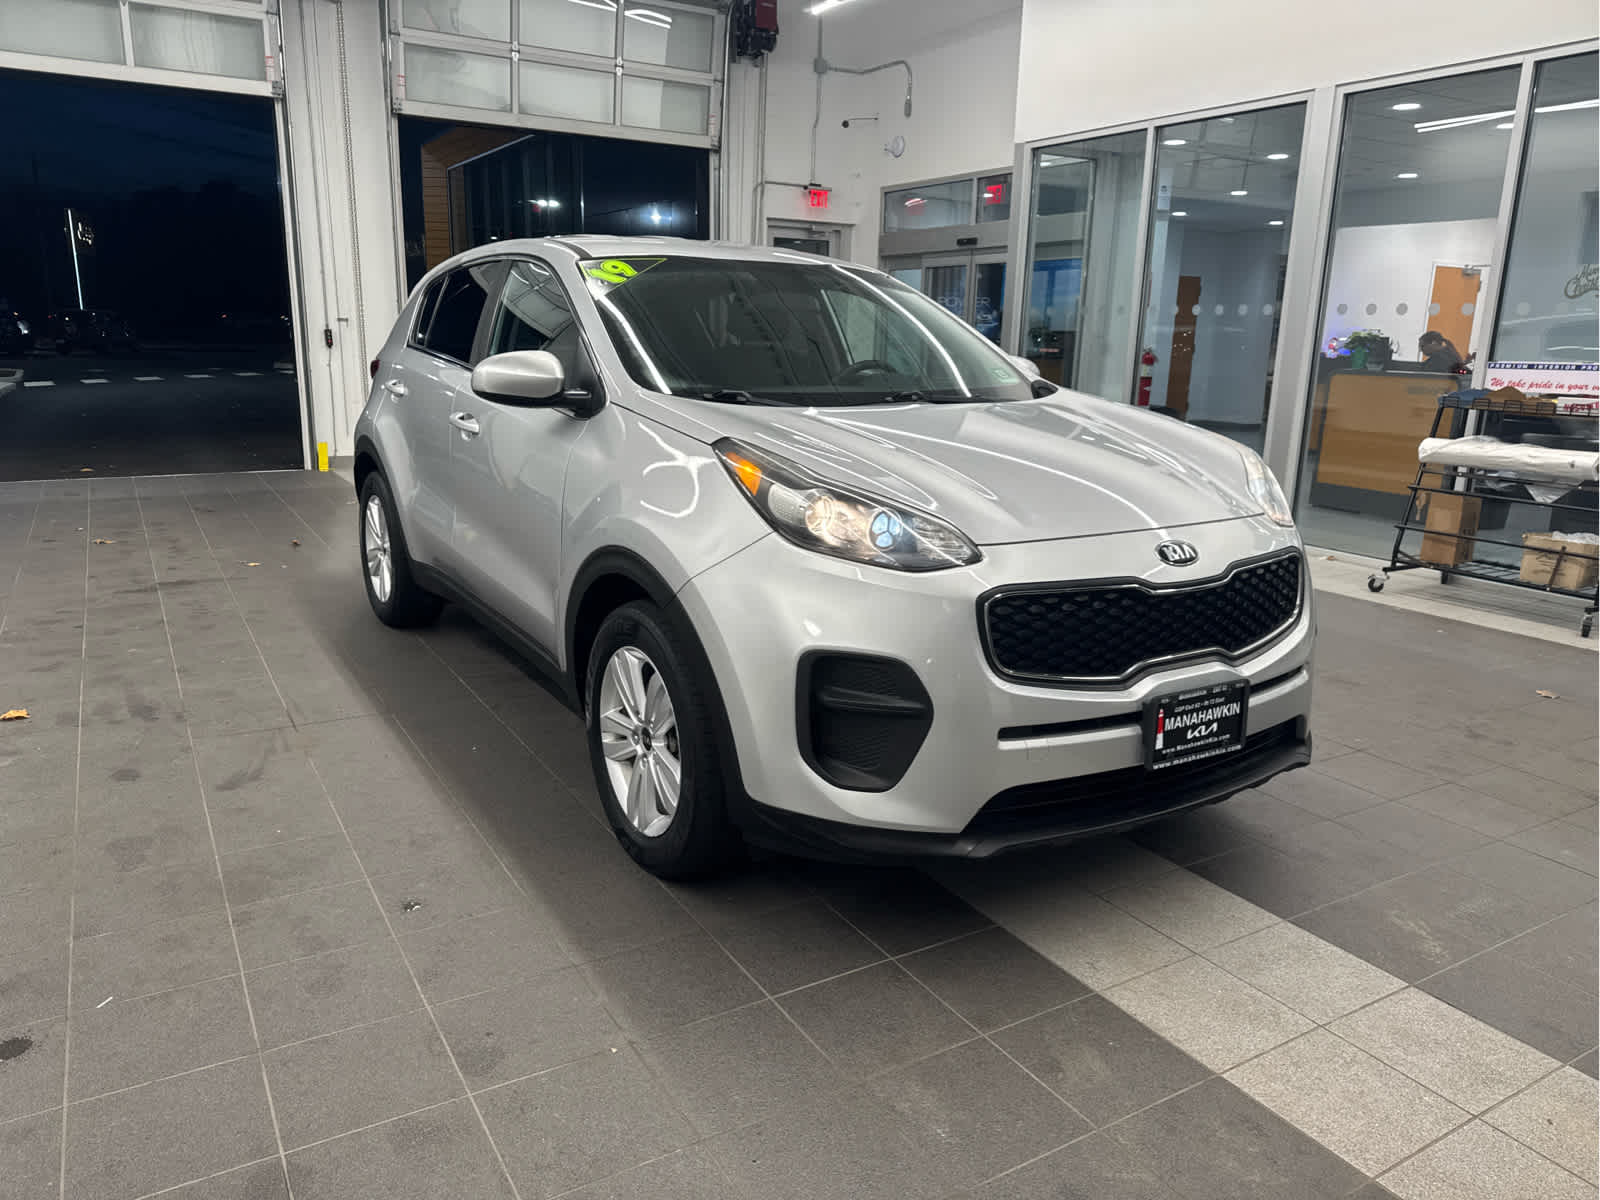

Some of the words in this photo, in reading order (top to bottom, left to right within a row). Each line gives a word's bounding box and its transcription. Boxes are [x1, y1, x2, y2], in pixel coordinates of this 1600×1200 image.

[809, 190, 828, 208] EXIT
[587, 260, 638, 284] 19
[1490, 377, 1505, 387] We
[1507, 379, 1527, 388] take
[1527, 380, 1553, 390] pride
[1555, 382, 1565, 390] in
[1567, 383, 1590, 392] your
[1162, 545, 1196, 561] KIA
[1164, 701, 1241, 731] MANAHAWKIN
